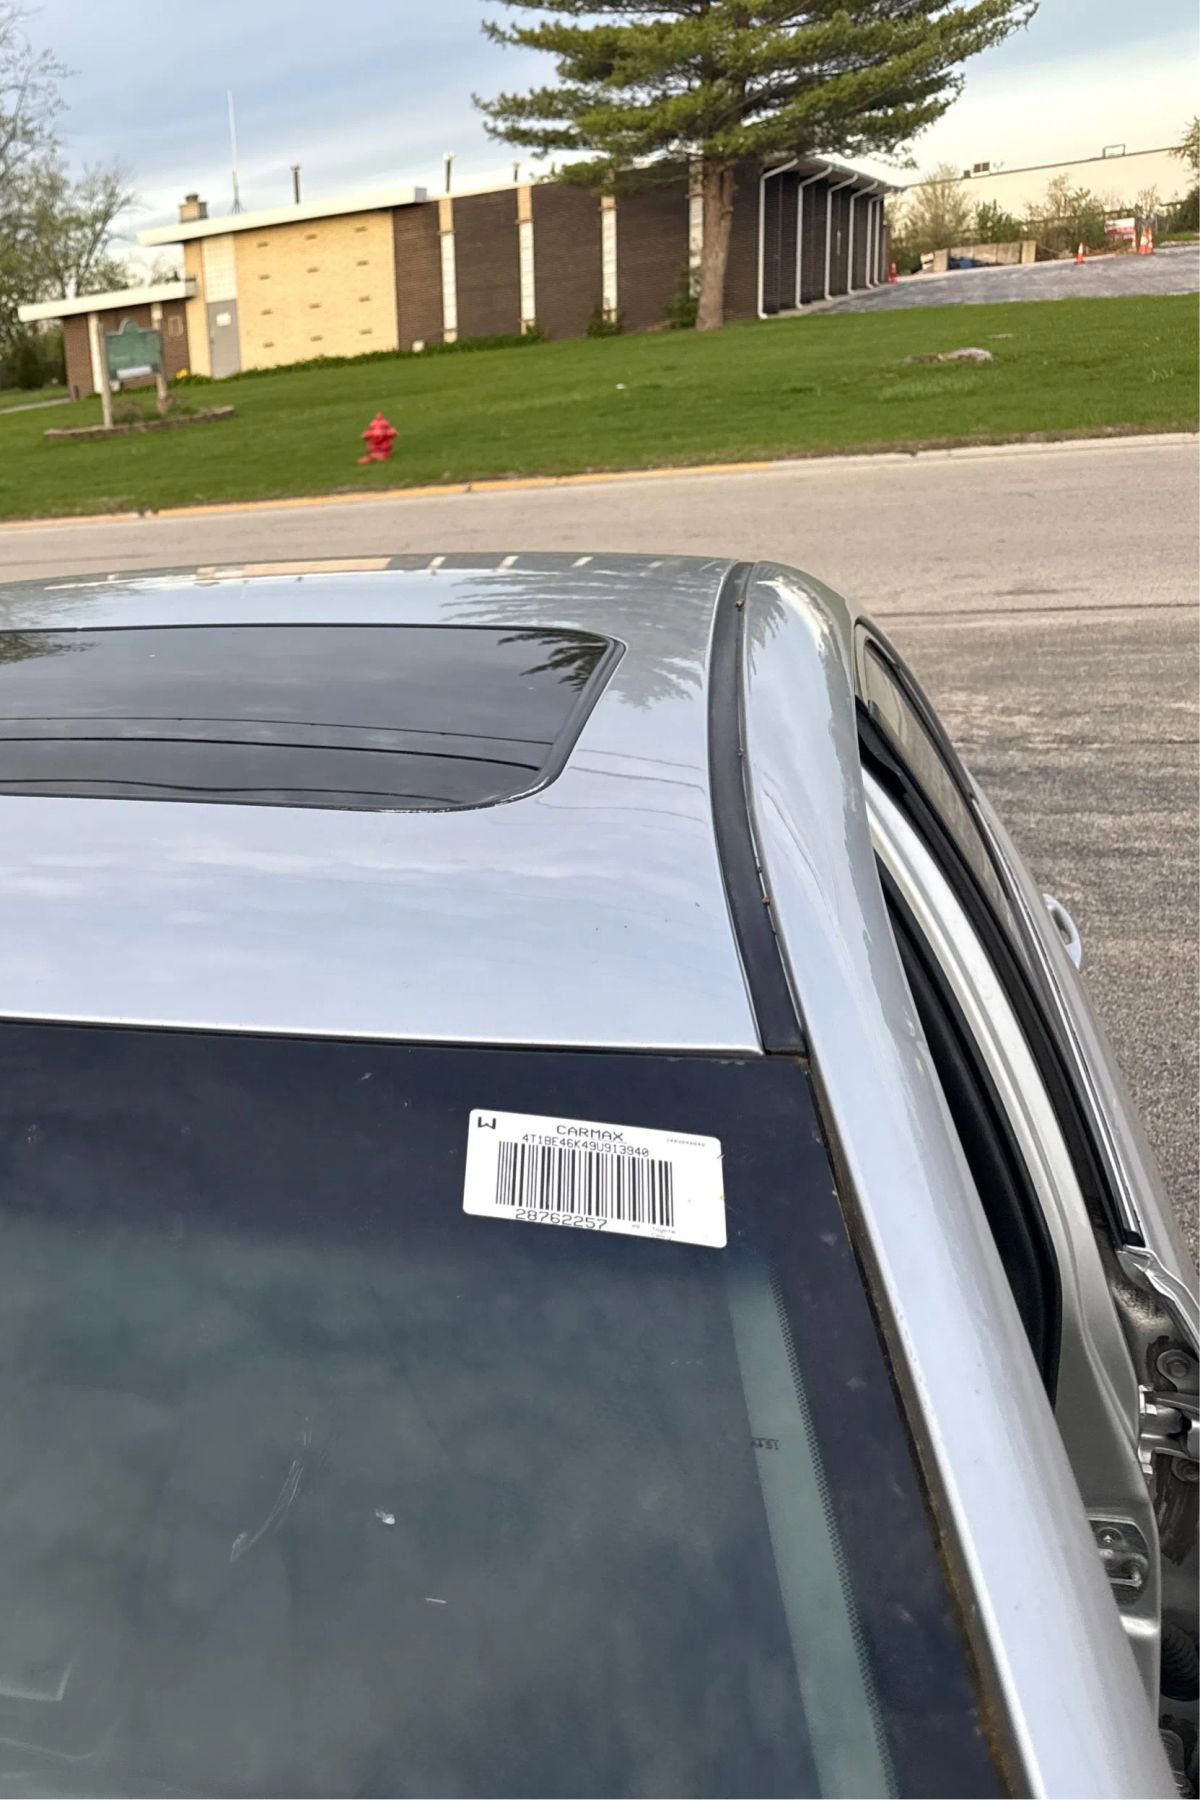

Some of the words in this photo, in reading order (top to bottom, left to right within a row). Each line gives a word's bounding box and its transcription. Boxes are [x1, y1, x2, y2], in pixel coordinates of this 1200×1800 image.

[477, 1116, 497, 1130] W
[556, 1124, 624, 1142] CARMAX
[522, 1133, 650, 1157] 4T1BE46K49U913940
[514, 1208, 608, 1230] 28762257
